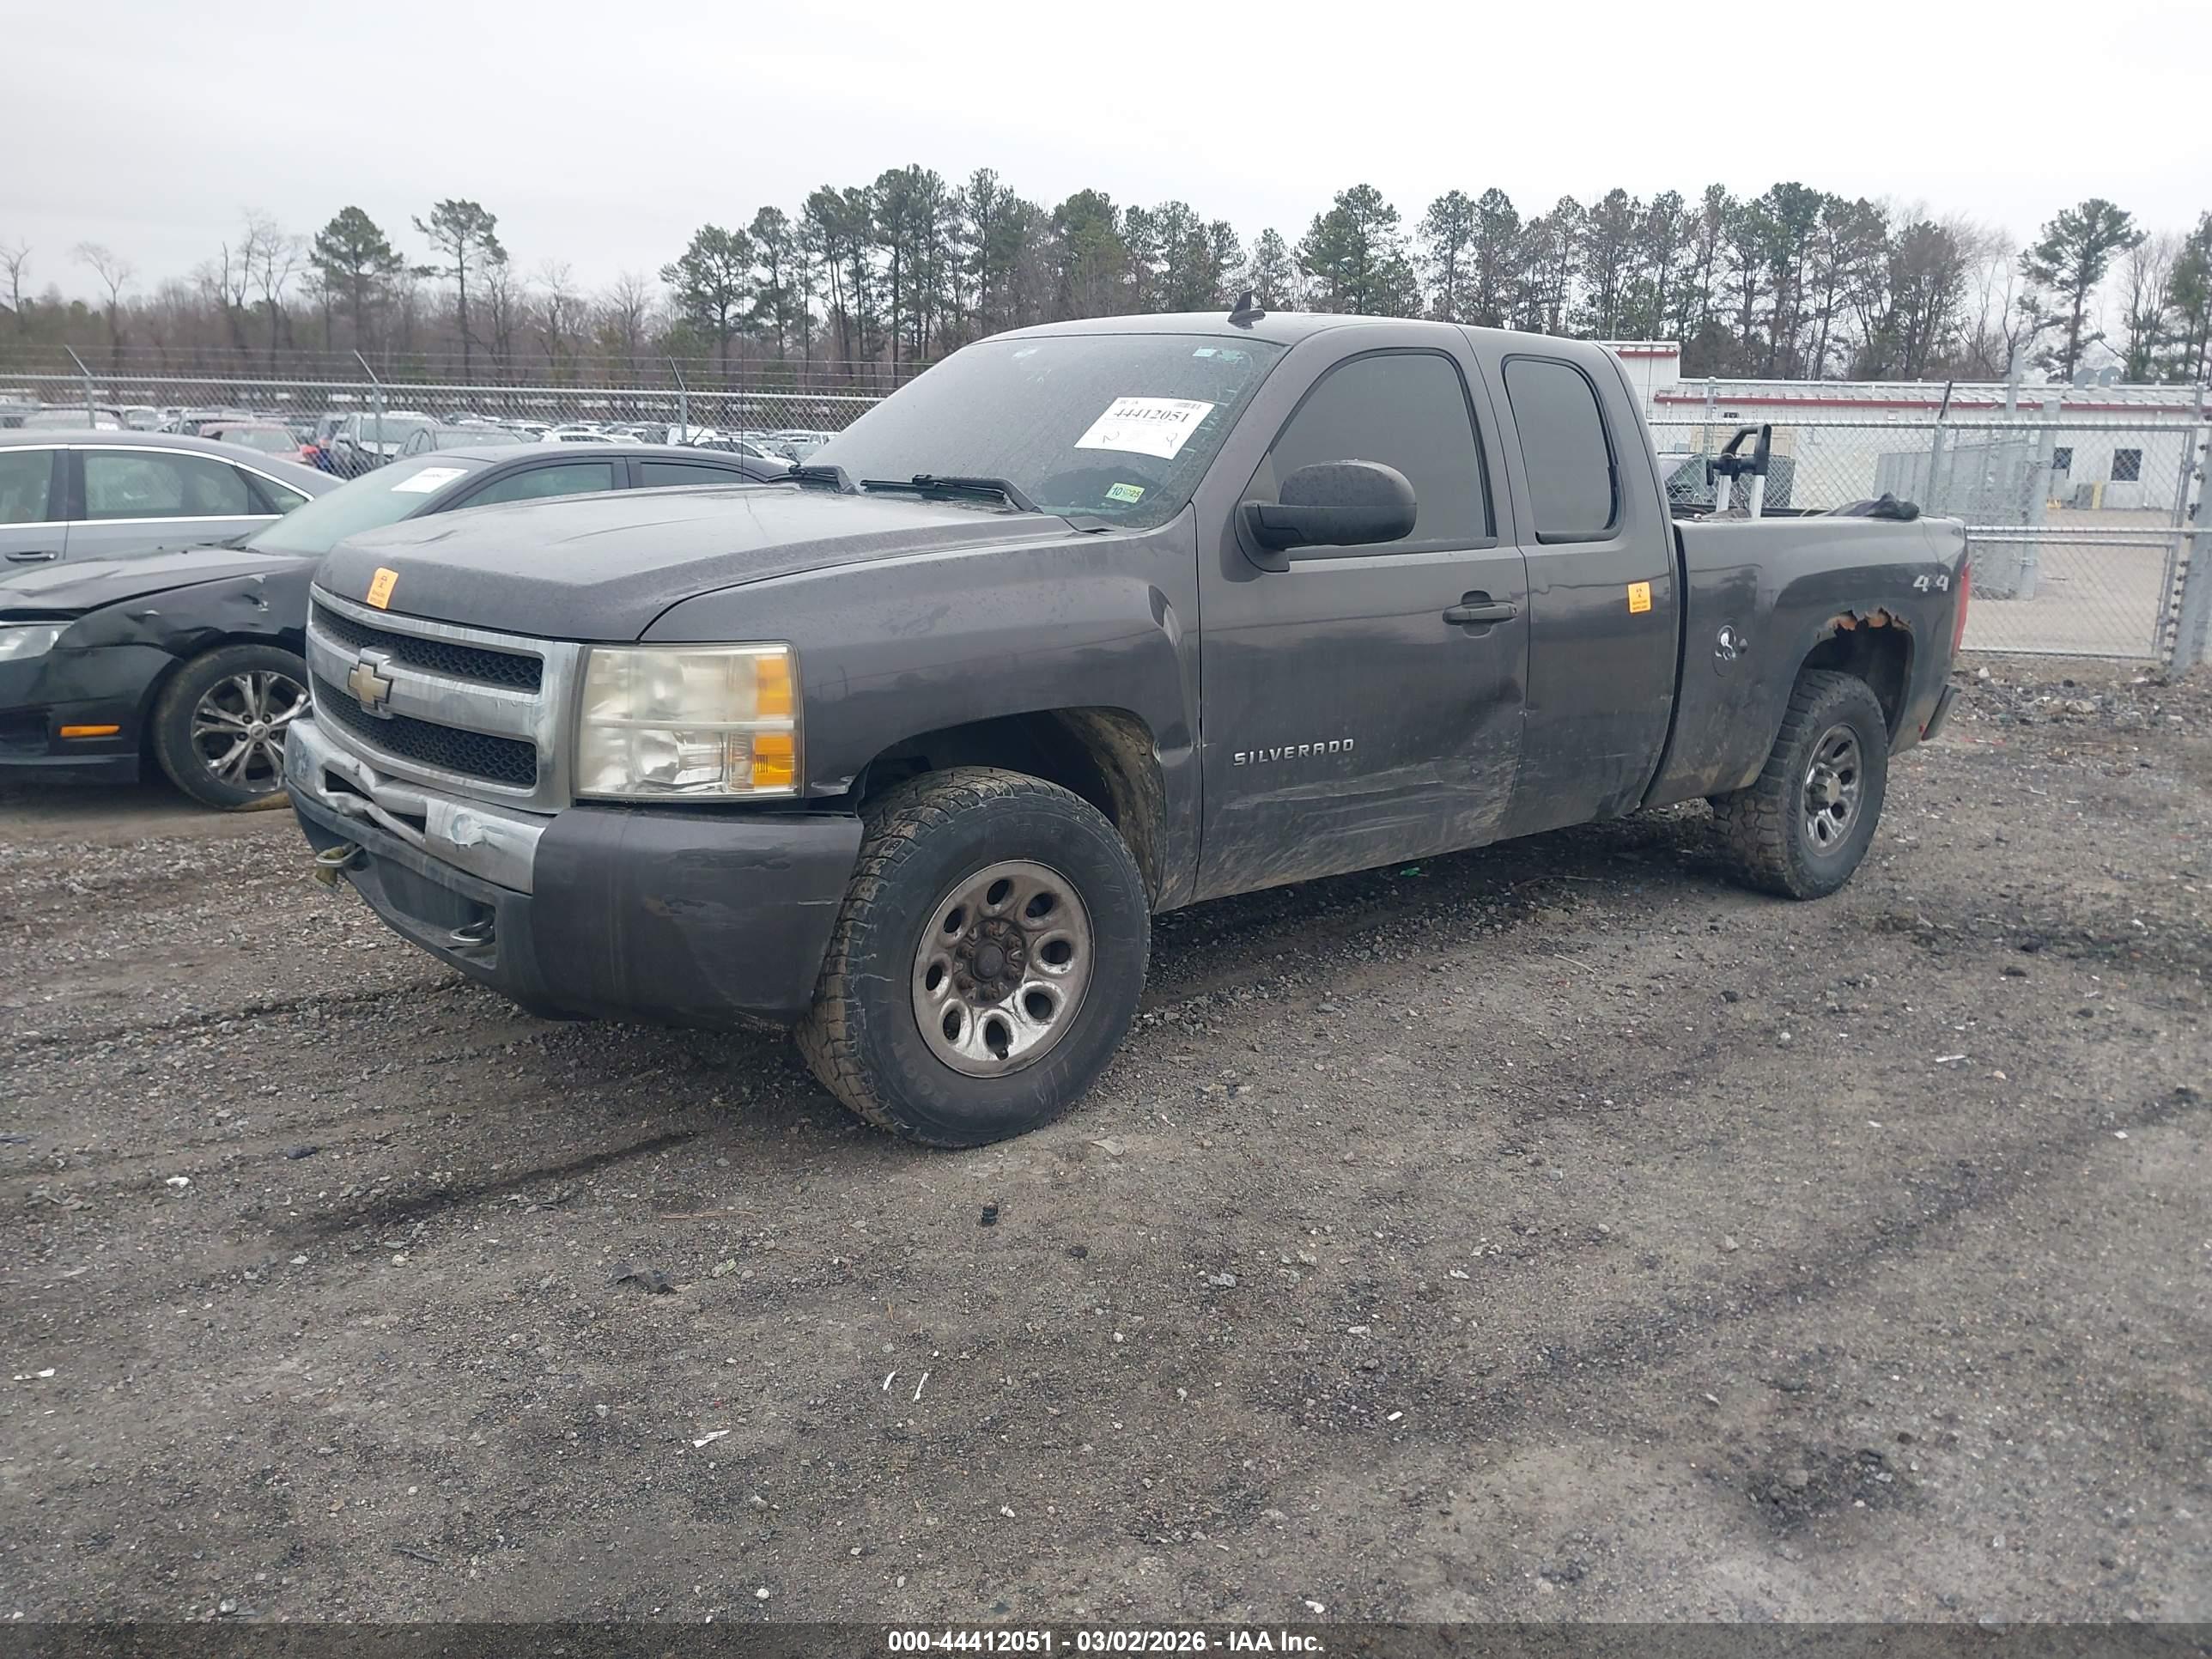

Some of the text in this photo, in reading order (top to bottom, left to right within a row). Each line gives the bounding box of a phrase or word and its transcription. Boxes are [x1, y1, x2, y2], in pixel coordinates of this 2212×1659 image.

[1115, 408, 1190, 422] 44412051
[1112, 486, 1141, 498] 10 25
[1233, 738, 1355, 767] SILVERADO
